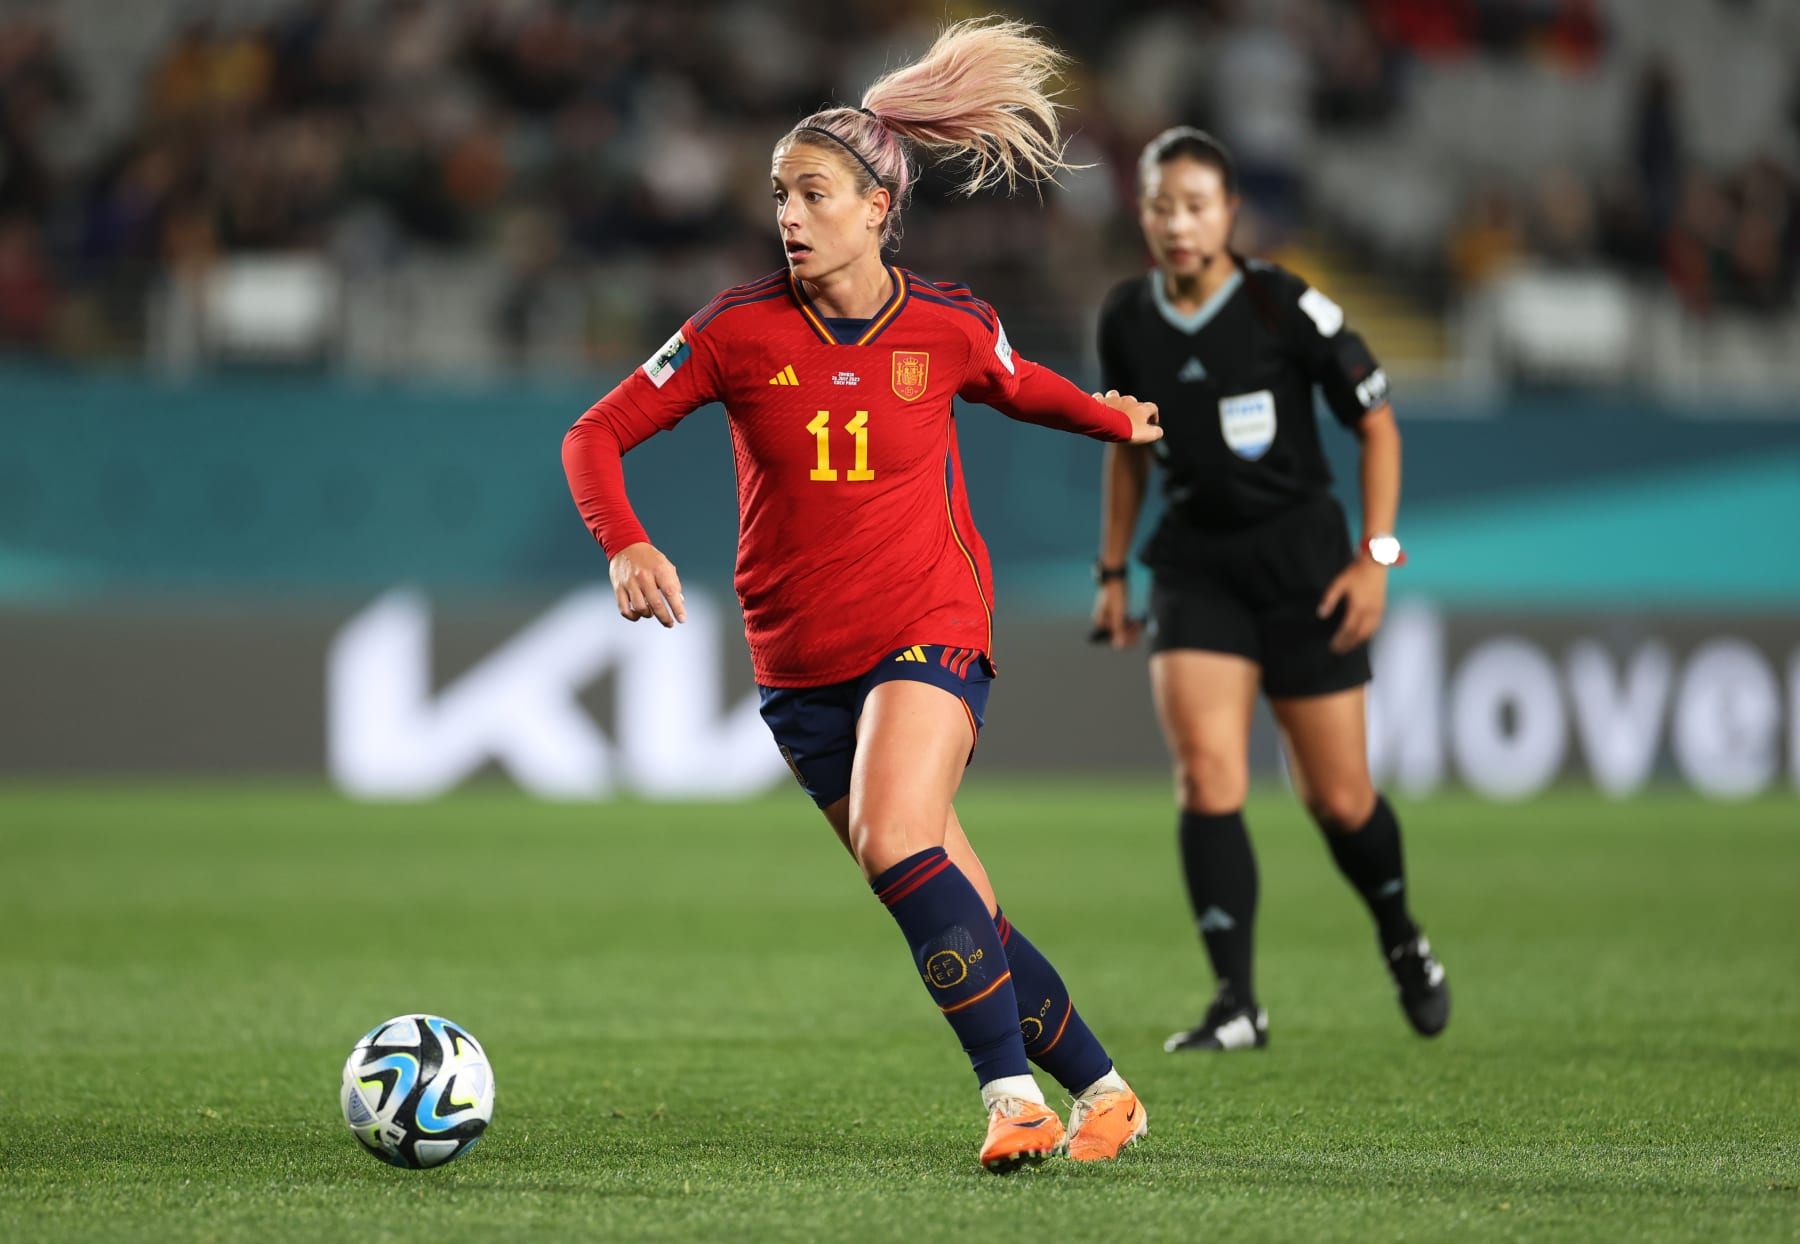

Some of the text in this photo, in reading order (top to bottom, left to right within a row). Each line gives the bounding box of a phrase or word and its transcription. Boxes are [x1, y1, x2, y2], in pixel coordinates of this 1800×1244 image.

[806, 410, 875, 481] 11
[328, 583, 795, 800] KI
[968, 948, 983, 964] 09
